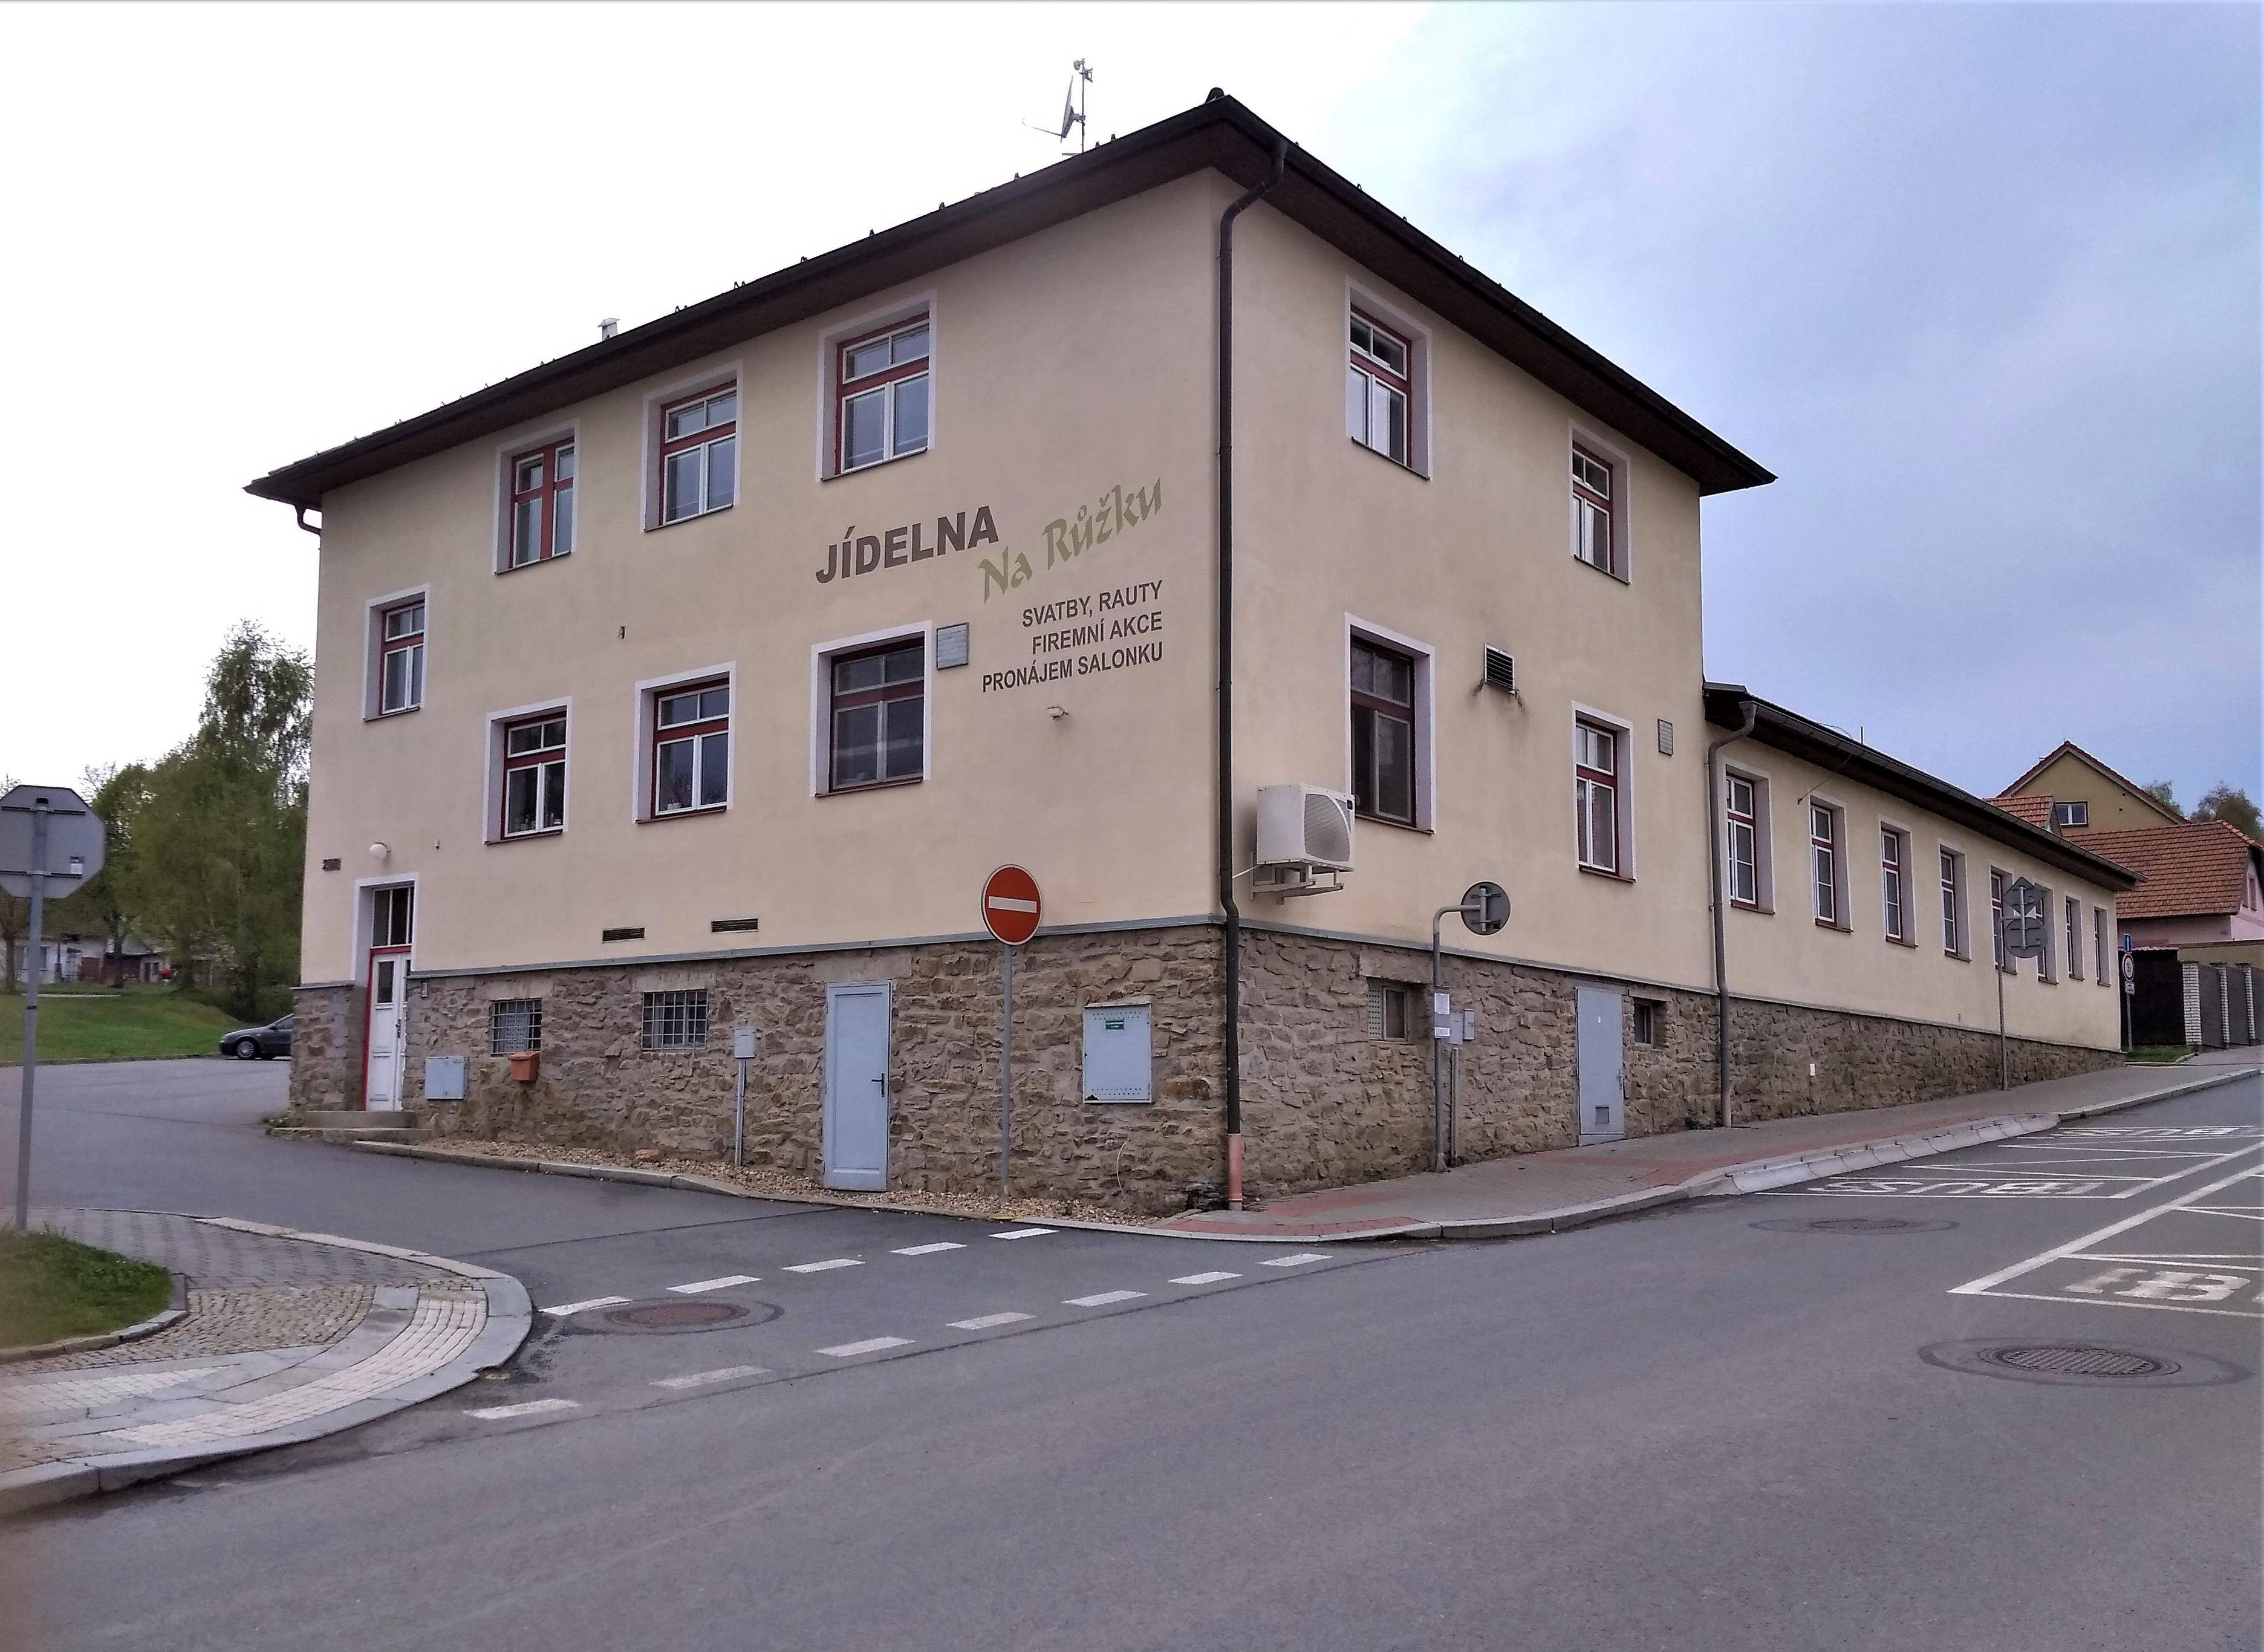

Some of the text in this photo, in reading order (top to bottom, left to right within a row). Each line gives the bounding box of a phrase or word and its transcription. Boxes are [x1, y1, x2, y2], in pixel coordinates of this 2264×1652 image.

[816, 506, 1000, 583] JÍDELNA
[978, 477, 1162, 603] Na Růžku
[1022, 580, 1163, 627] SVATBY, RAUTY
[1032, 611, 1163, 654] FIREMNÍ AKCE
[982, 642, 1163, 693] PRONÁJEM SALONKU
